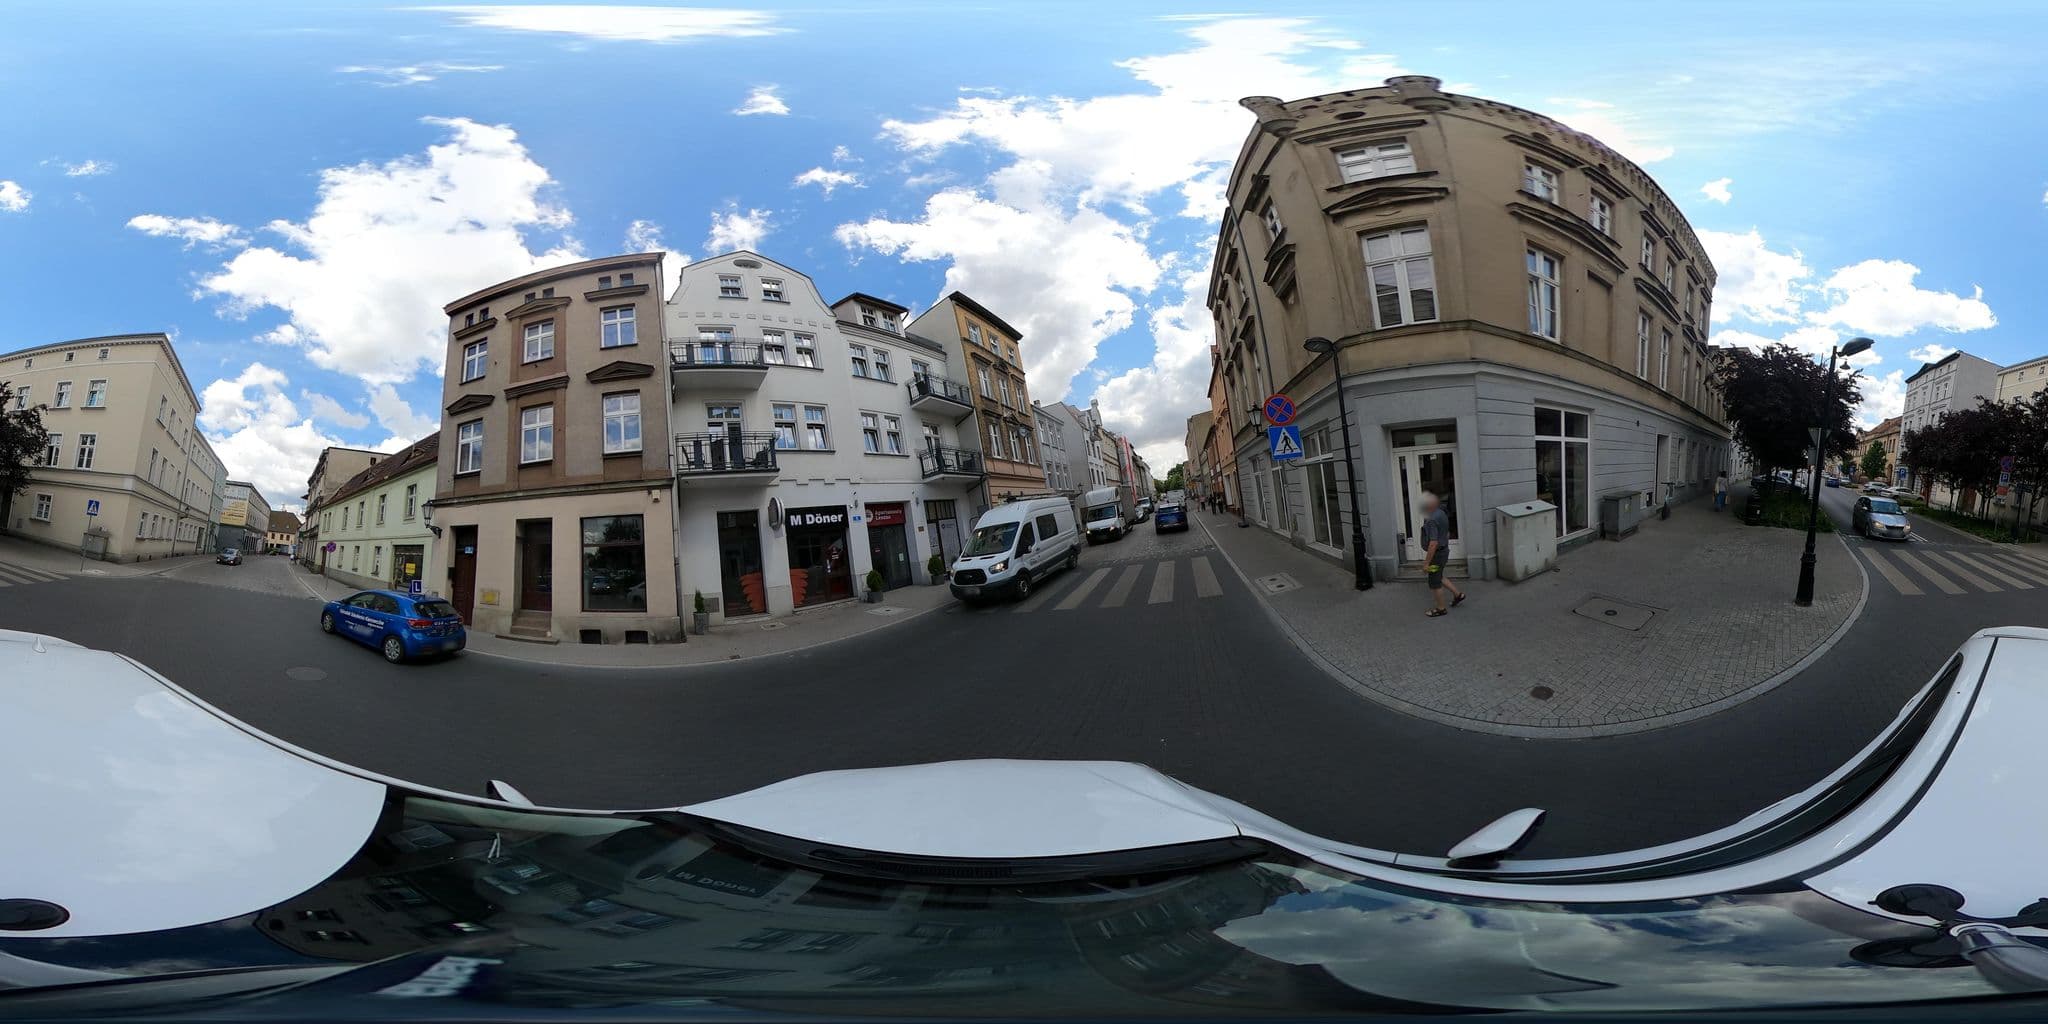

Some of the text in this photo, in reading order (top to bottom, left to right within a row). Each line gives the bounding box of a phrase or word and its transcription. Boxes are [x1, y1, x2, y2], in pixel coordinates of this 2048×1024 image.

[790, 515, 802, 526] M
[805, 513, 843, 525] Döner
[415, 582, 420, 591] L
